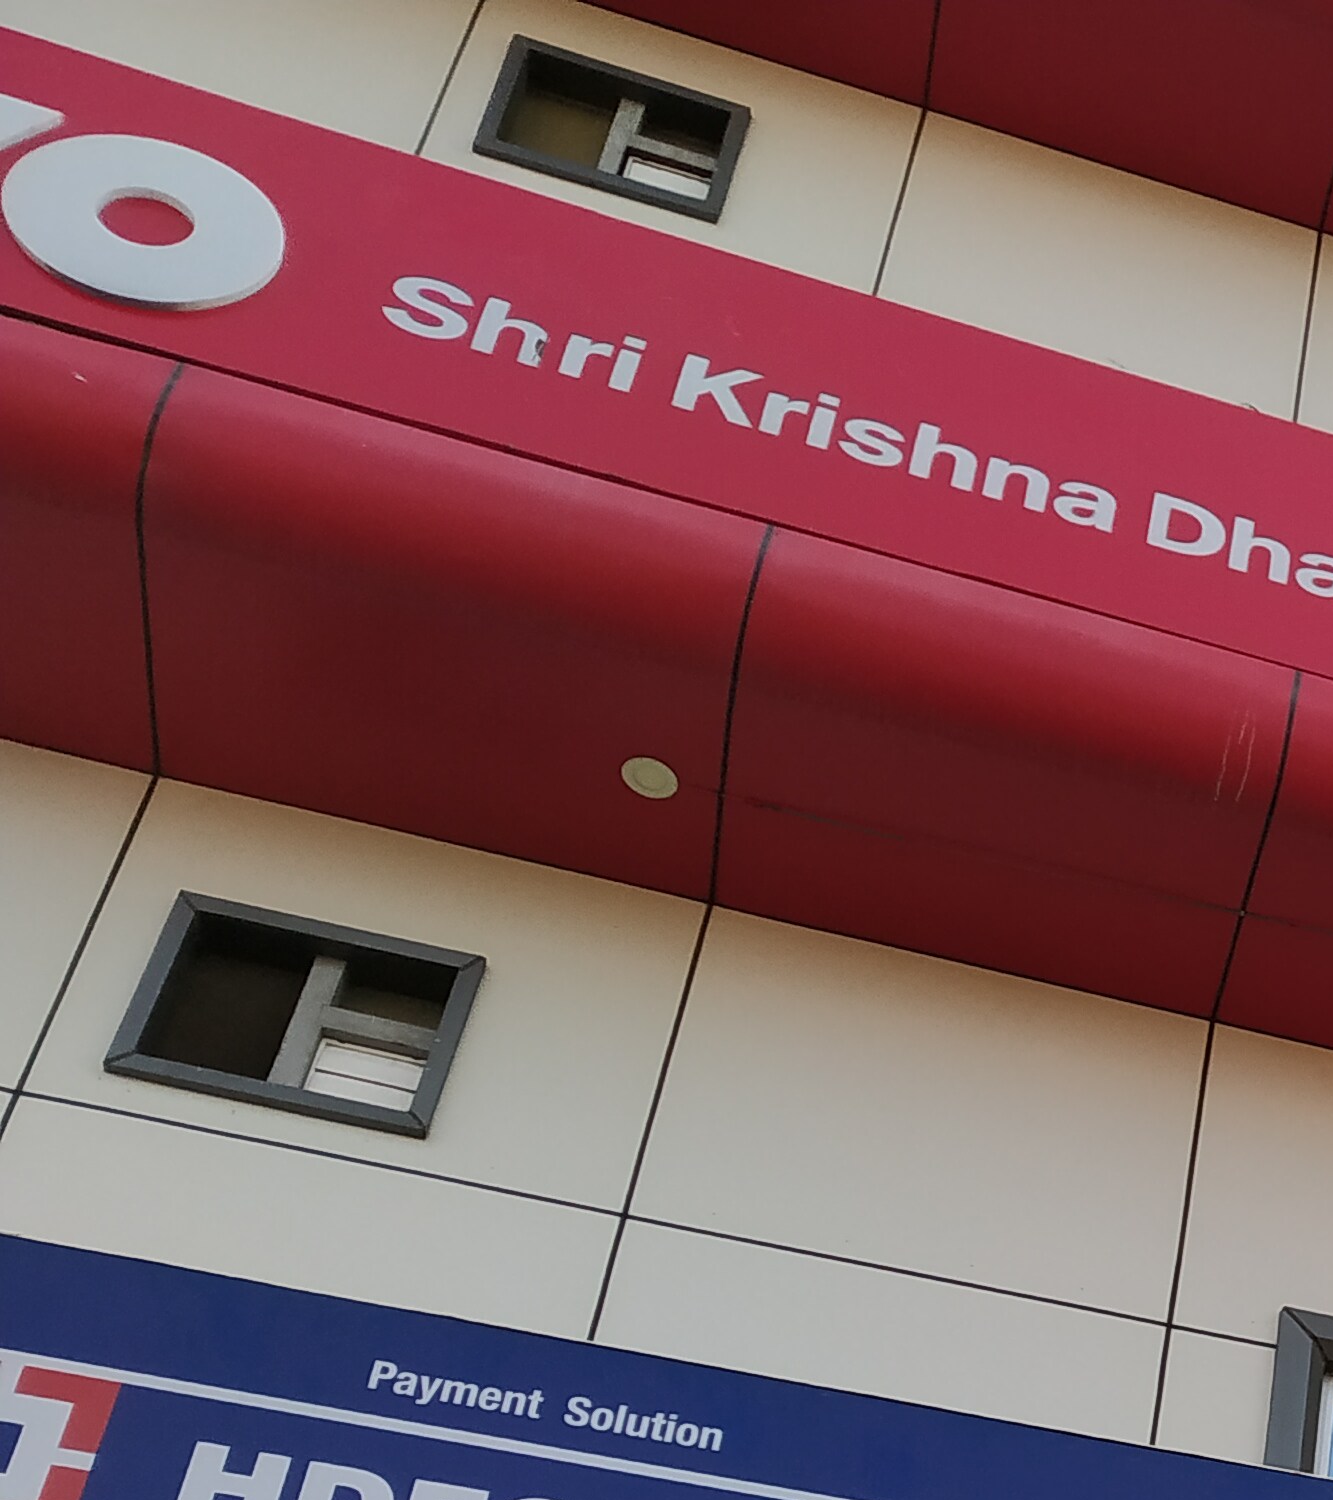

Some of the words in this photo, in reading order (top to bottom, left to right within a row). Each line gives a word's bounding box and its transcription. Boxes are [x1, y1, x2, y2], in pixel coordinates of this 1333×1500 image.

[0, 93, 285, 312] O
[381, 275, 645, 393] Shri
[671, 352, 1117, 534] Krishna
[367, 1358, 545, 1420] Payment
[563, 1396, 724, 1453] Solution
